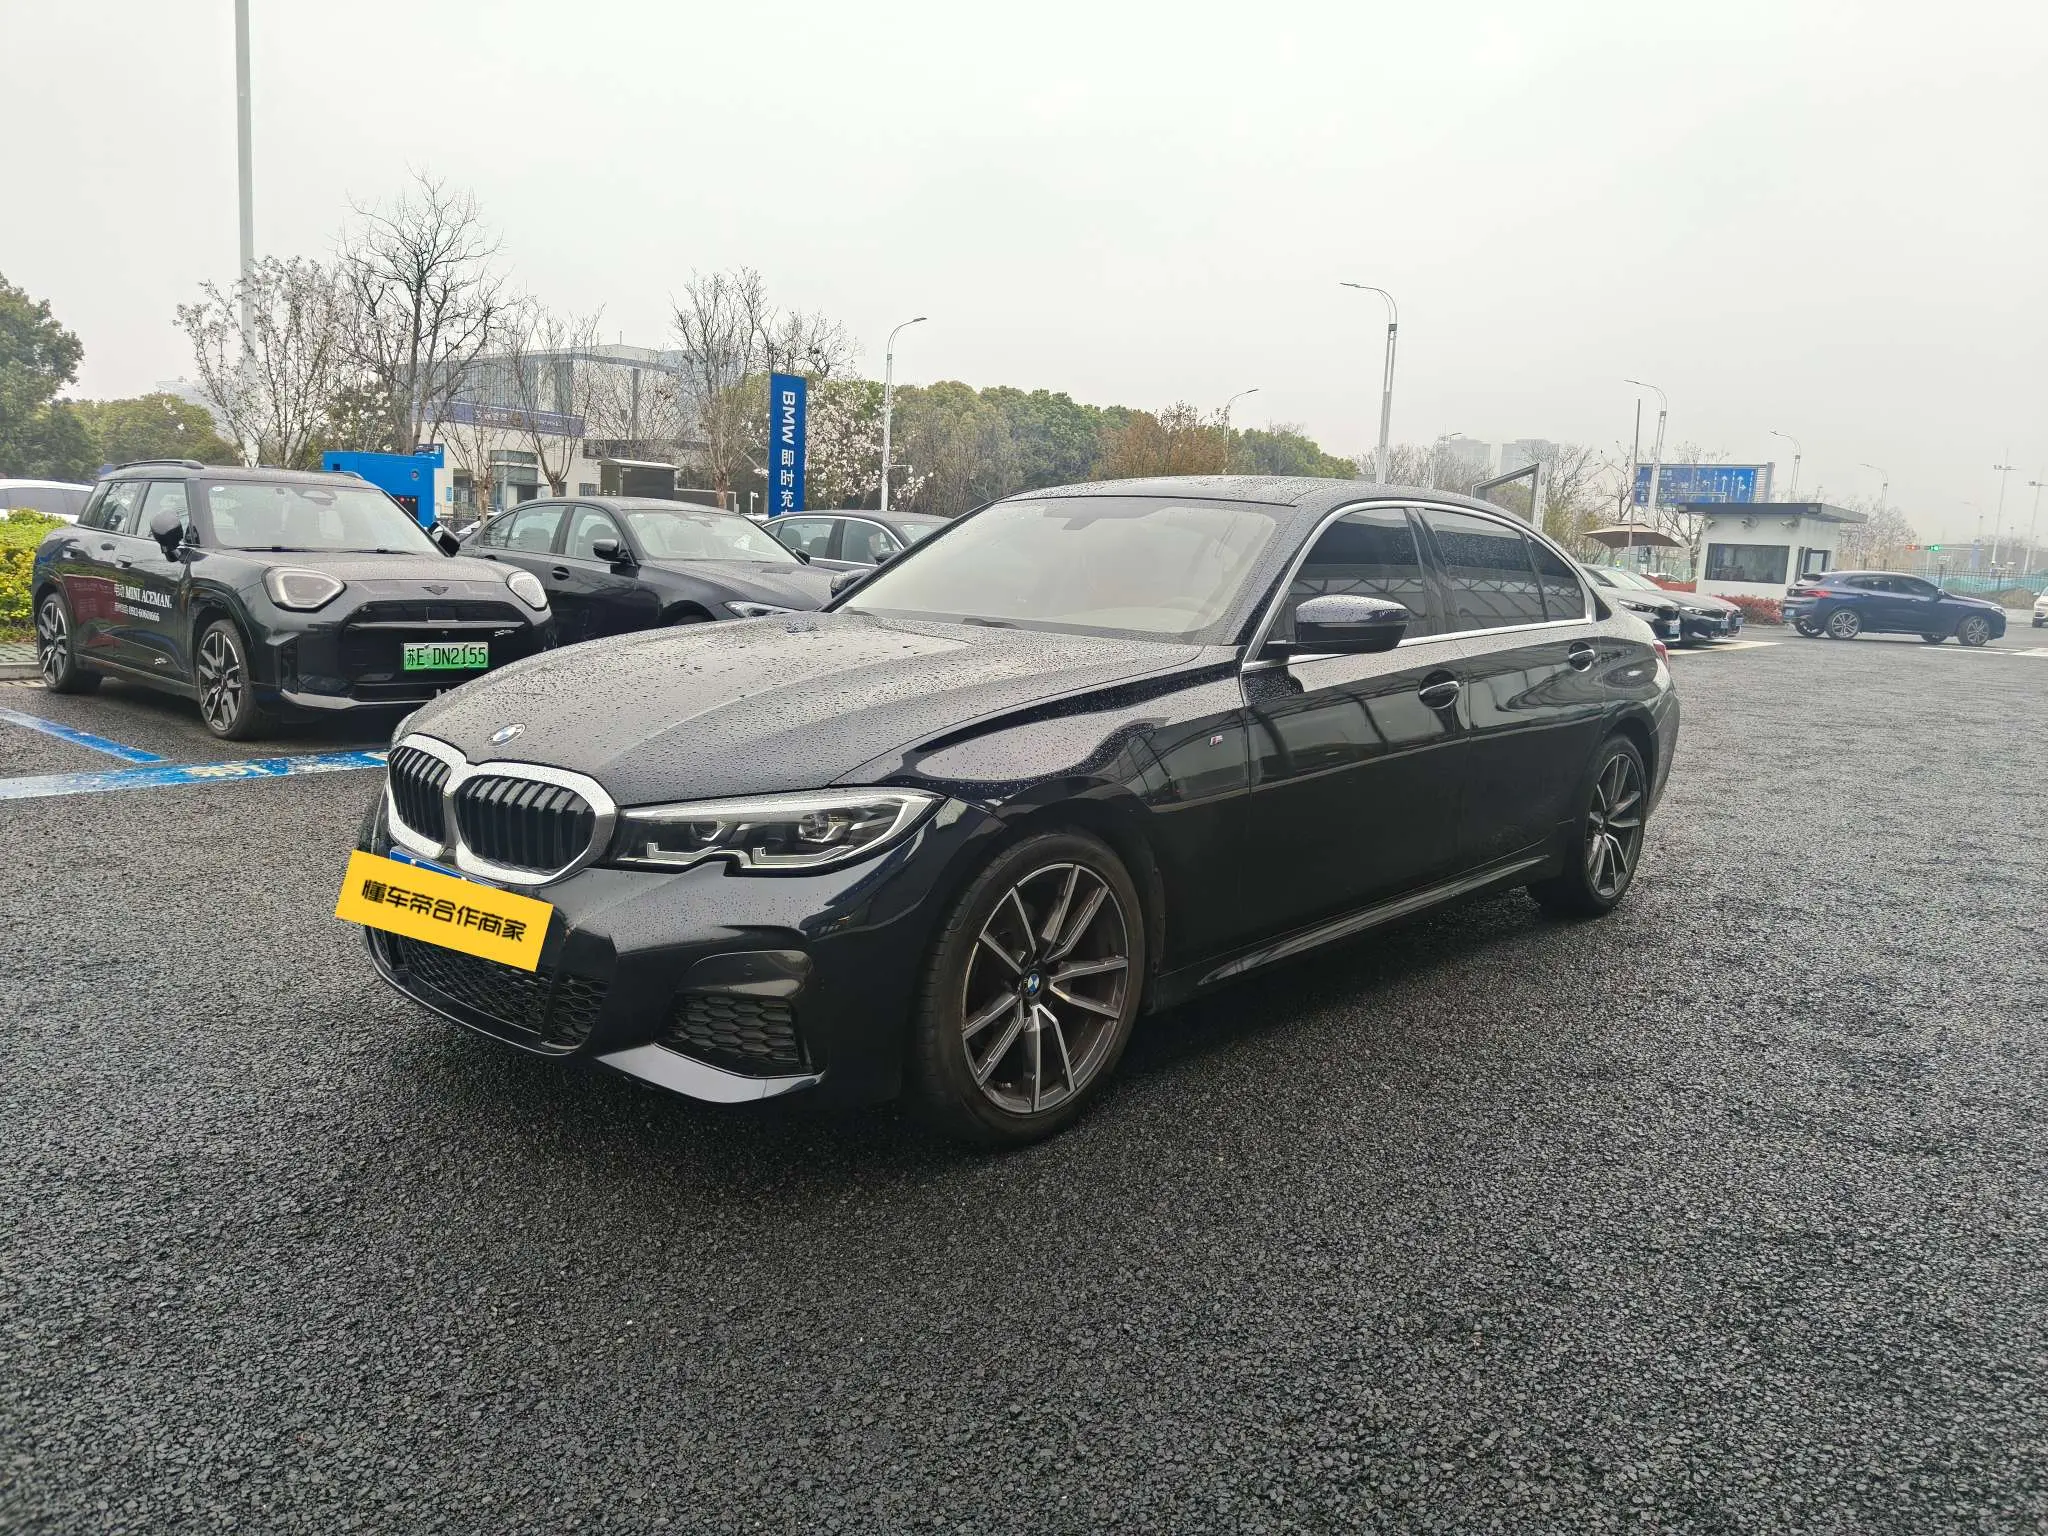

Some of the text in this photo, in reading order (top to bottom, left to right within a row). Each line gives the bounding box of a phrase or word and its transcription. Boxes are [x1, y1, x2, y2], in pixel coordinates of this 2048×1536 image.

[780, 391, 796, 516] BMW 即时充
[125, 585, 142, 602] MINI
[432, 647, 486, 666] DN2155
